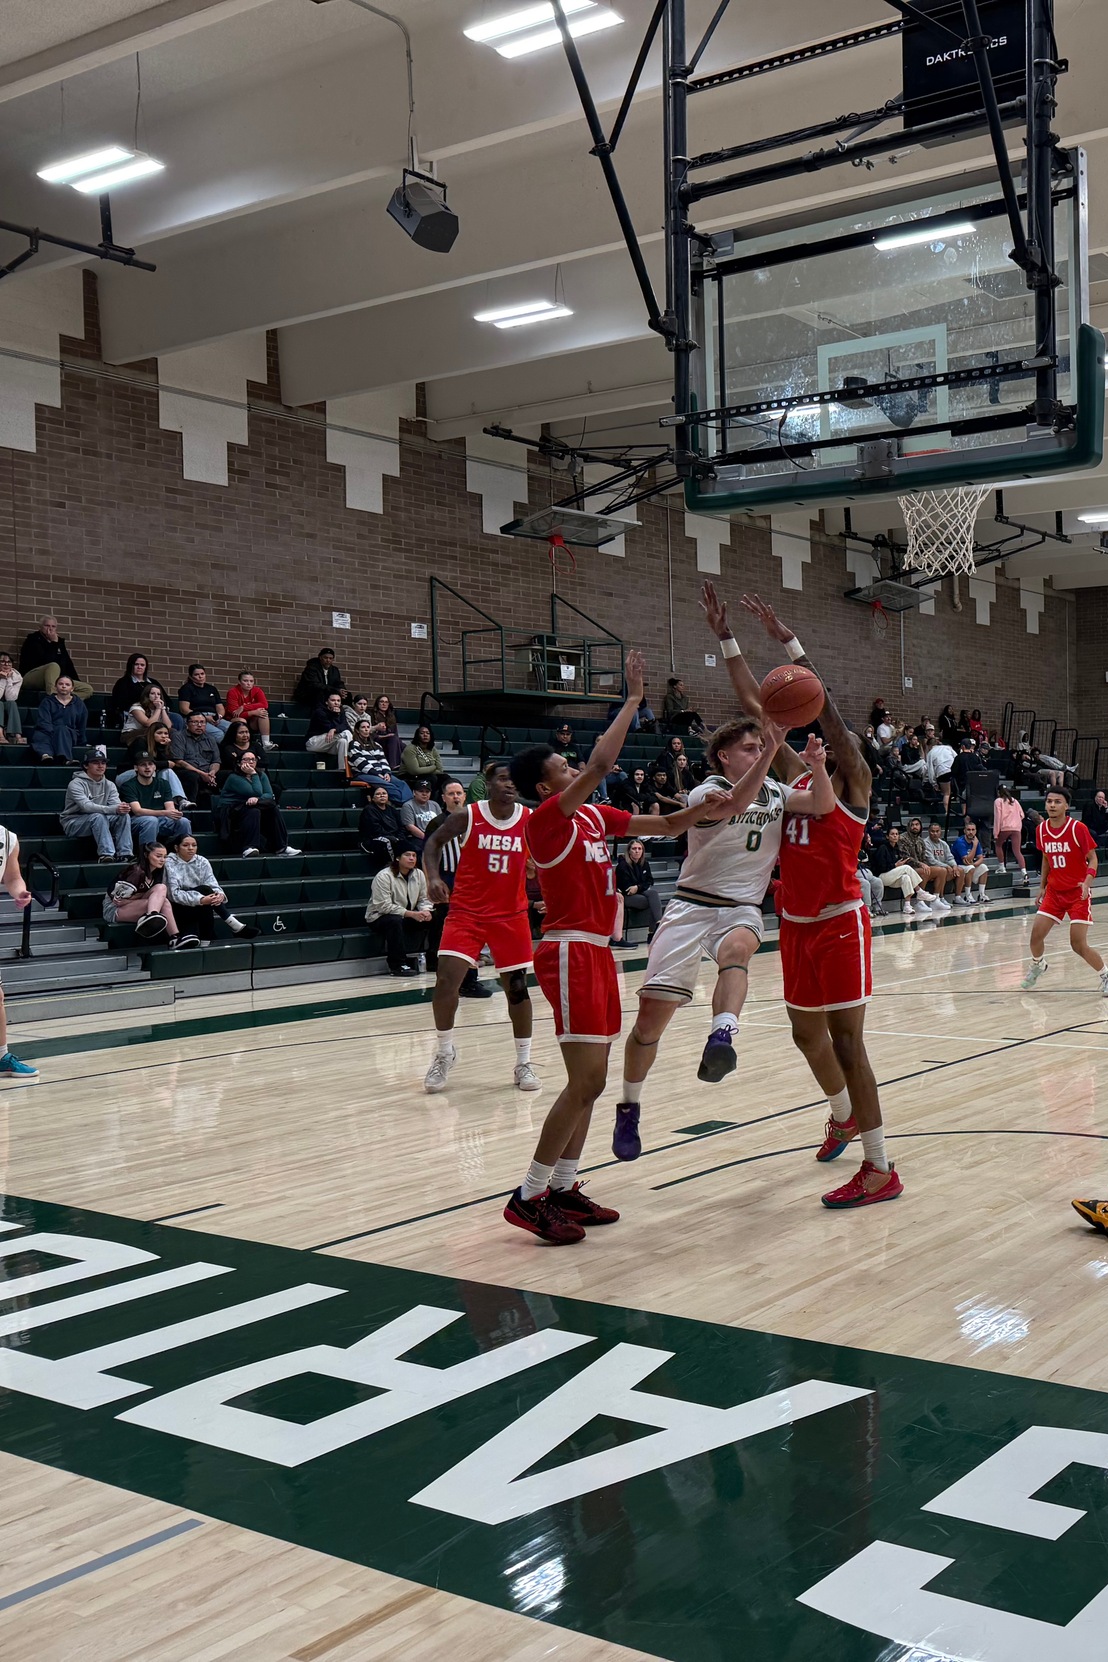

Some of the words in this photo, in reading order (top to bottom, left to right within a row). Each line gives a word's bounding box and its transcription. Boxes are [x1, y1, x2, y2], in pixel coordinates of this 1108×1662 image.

[926, 36, 1007, 66] DAKTRCS
[746, 830, 762, 852] 0
[786, 818, 810, 846] 41
[478, 834, 522, 852] MESA
[583, 840, 611, 863] ME
[1044, 842, 1071, 853] MESA
[488, 854, 509, 874] 51
[1052, 856, 1066, 868] 10
